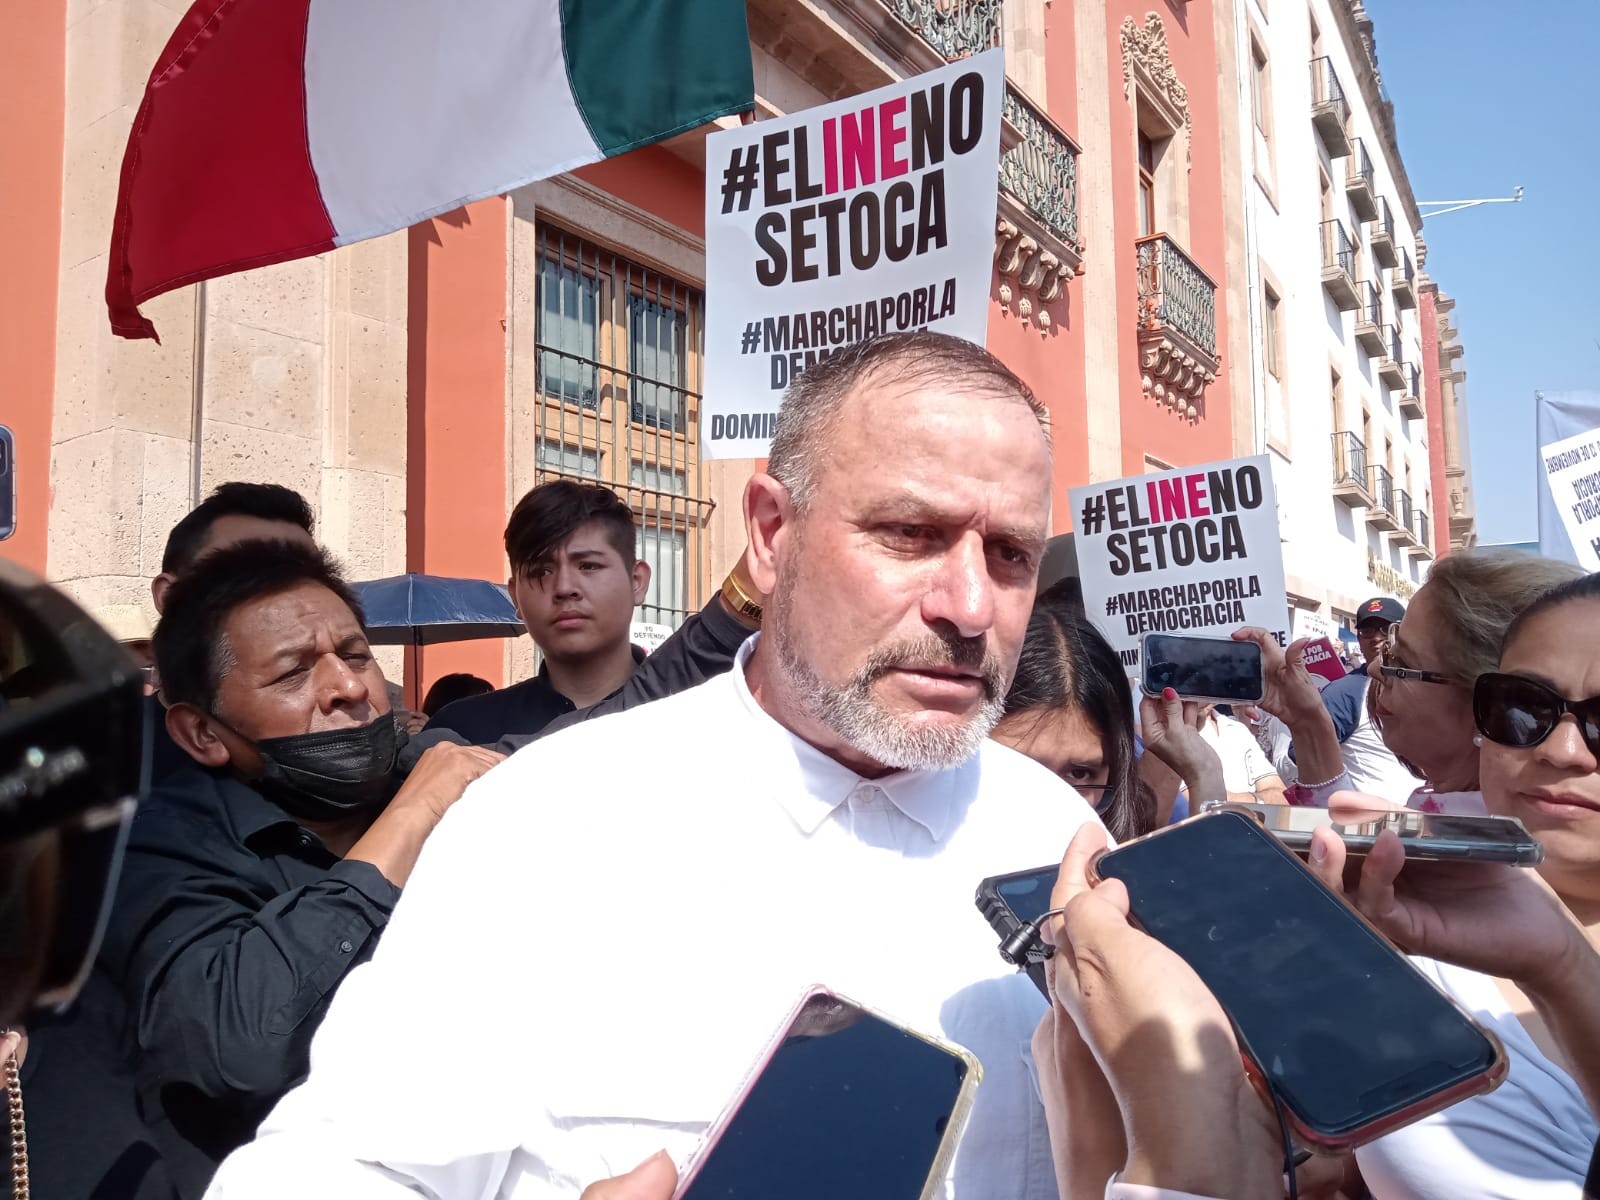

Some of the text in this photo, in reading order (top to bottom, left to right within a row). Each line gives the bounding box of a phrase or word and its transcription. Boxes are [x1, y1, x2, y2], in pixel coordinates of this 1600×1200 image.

[721, 71, 984, 214] #ELINENO
[755, 168, 948, 287] SETOCA
[741, 278, 956, 354] #MARCHAPORLA
[1082, 465, 1262, 535] #ELINENO
[1107, 515, 1247, 576] SETOCA
[1106, 575, 1261, 616] #MARCHAPORLA
[1126, 600, 1245, 635] DEMOCRACIA
[1304, 651, 1332, 664] CRACIA
